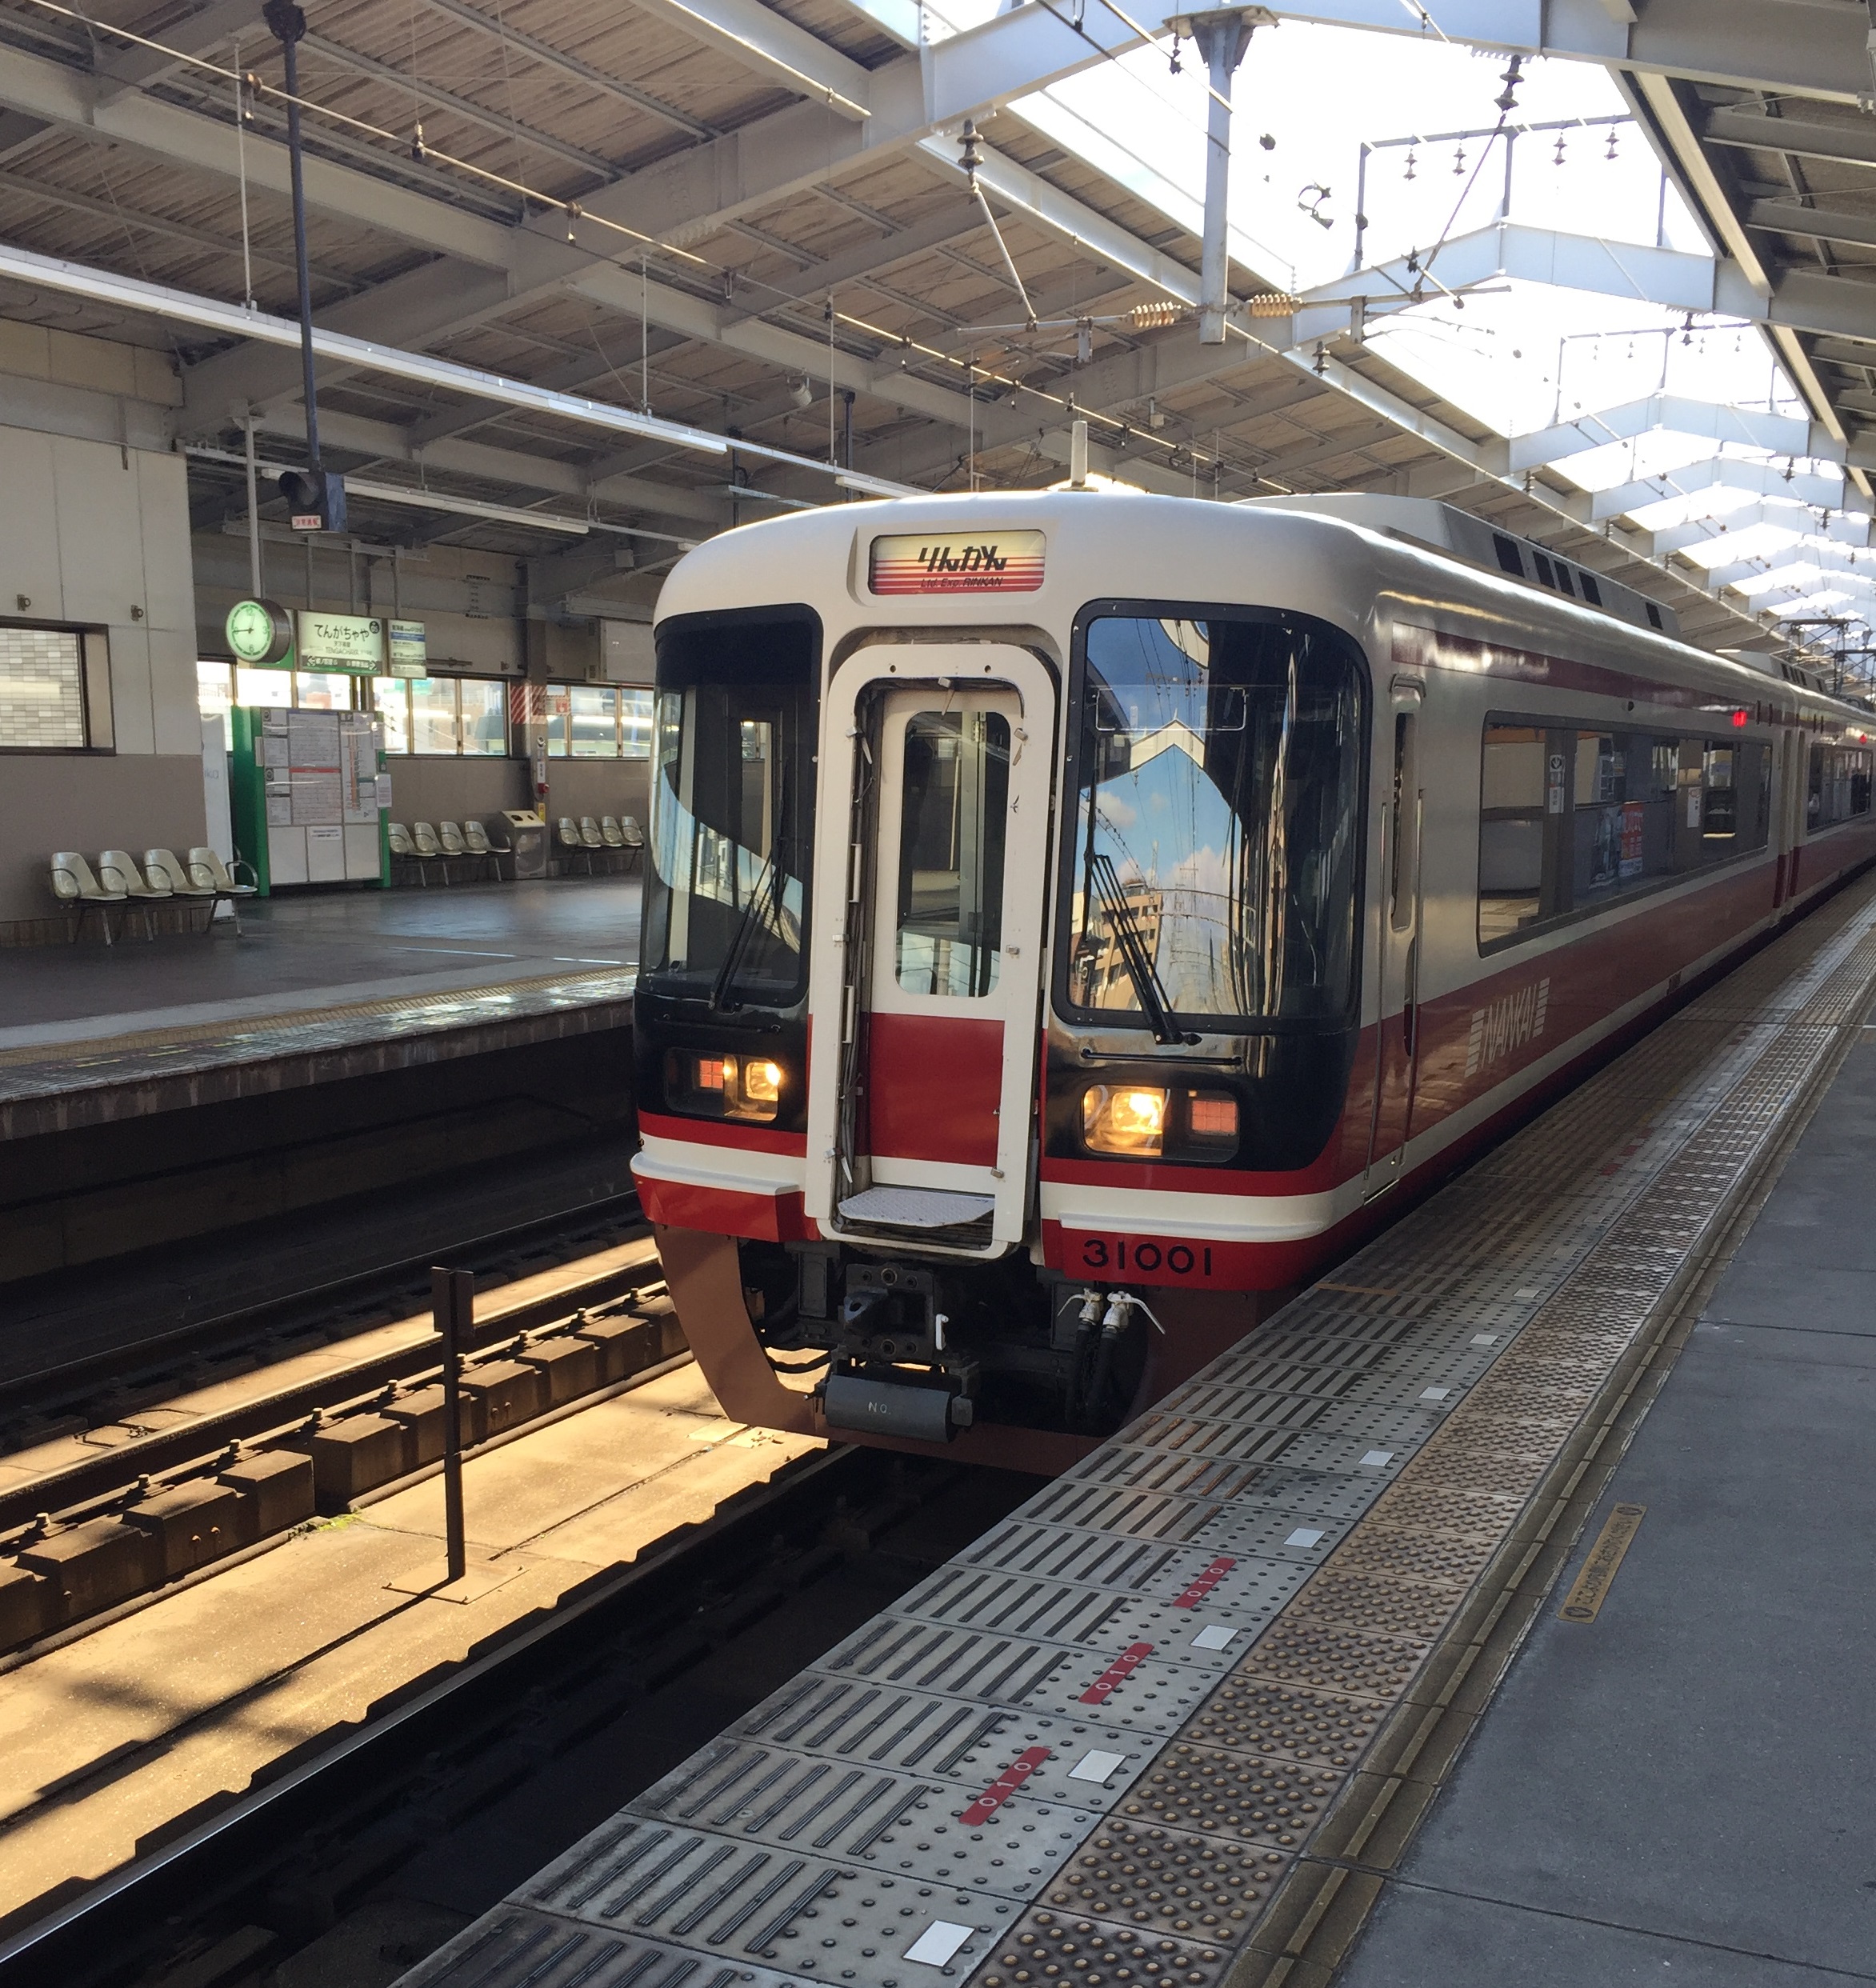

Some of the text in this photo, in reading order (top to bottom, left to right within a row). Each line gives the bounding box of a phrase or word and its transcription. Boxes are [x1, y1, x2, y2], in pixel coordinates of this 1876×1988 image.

[918, 546, 1008, 572] りんかん
[962, 578, 1003, 586] RINKAN
[314, 625, 370, 642] てんがちゃや
[249, 645, 254, 653] 6
[1481, 984, 1537, 1069] NANKAI
[1082, 1239, 1211, 1276] 31001
[1187, 1568, 1224, 1597] 010
[1095, 1654, 1139, 1690] 010
[970, 1762, 1032, 1806] 010
